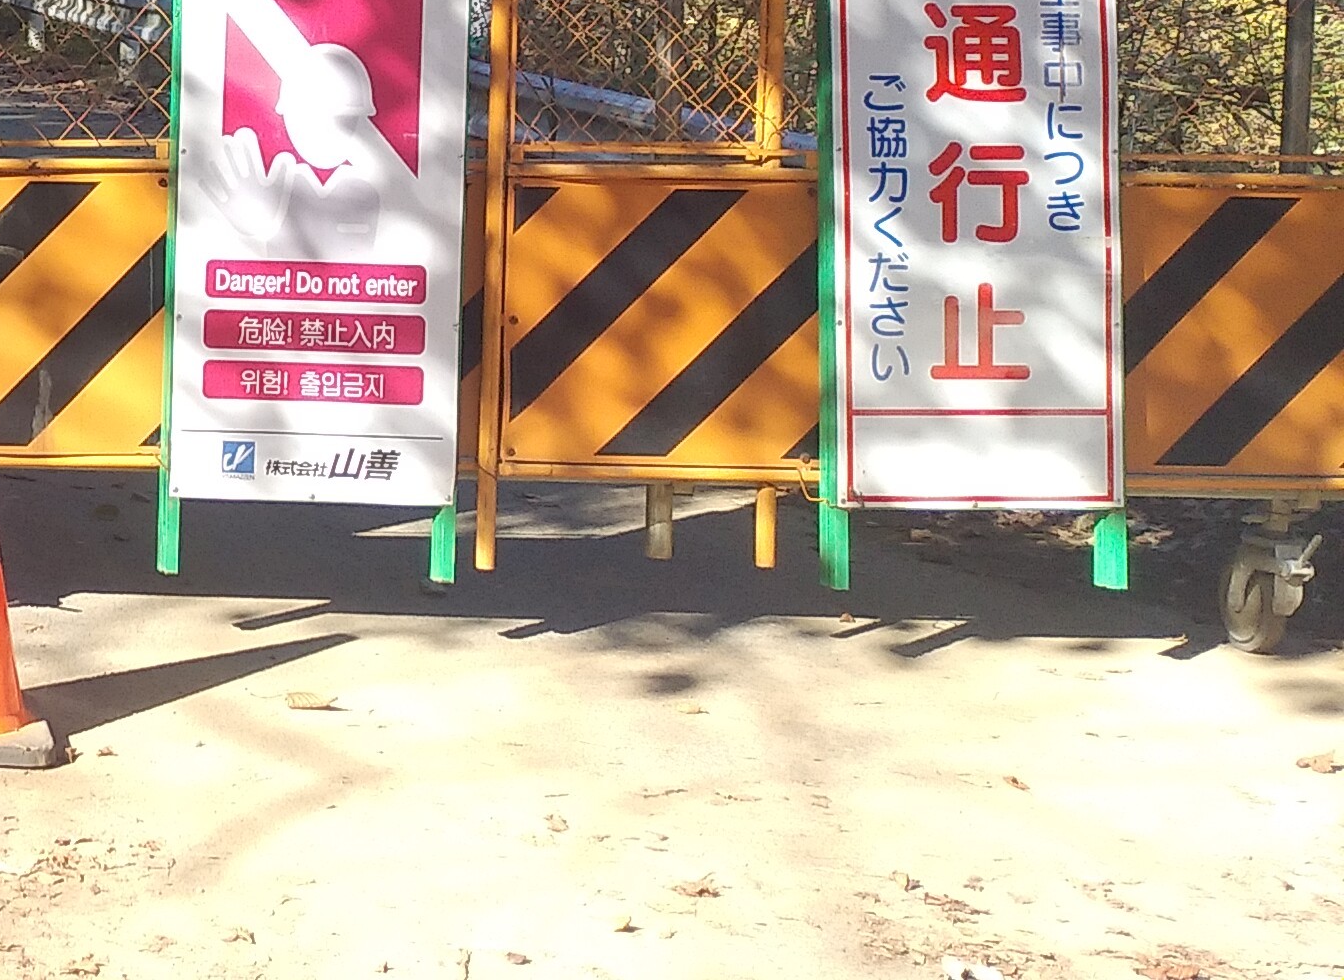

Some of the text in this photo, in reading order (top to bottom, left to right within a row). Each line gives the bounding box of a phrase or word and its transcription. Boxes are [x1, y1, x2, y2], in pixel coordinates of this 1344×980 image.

[923, 0, 1032, 382] 通行止
[861, 73, 911, 384] ご協力ください
[215, 268, 418, 297] Danger! Do not enter
[299, 319, 396, 350] 禁止入内
[239, 369, 386, 400] 위험! 출입금지
